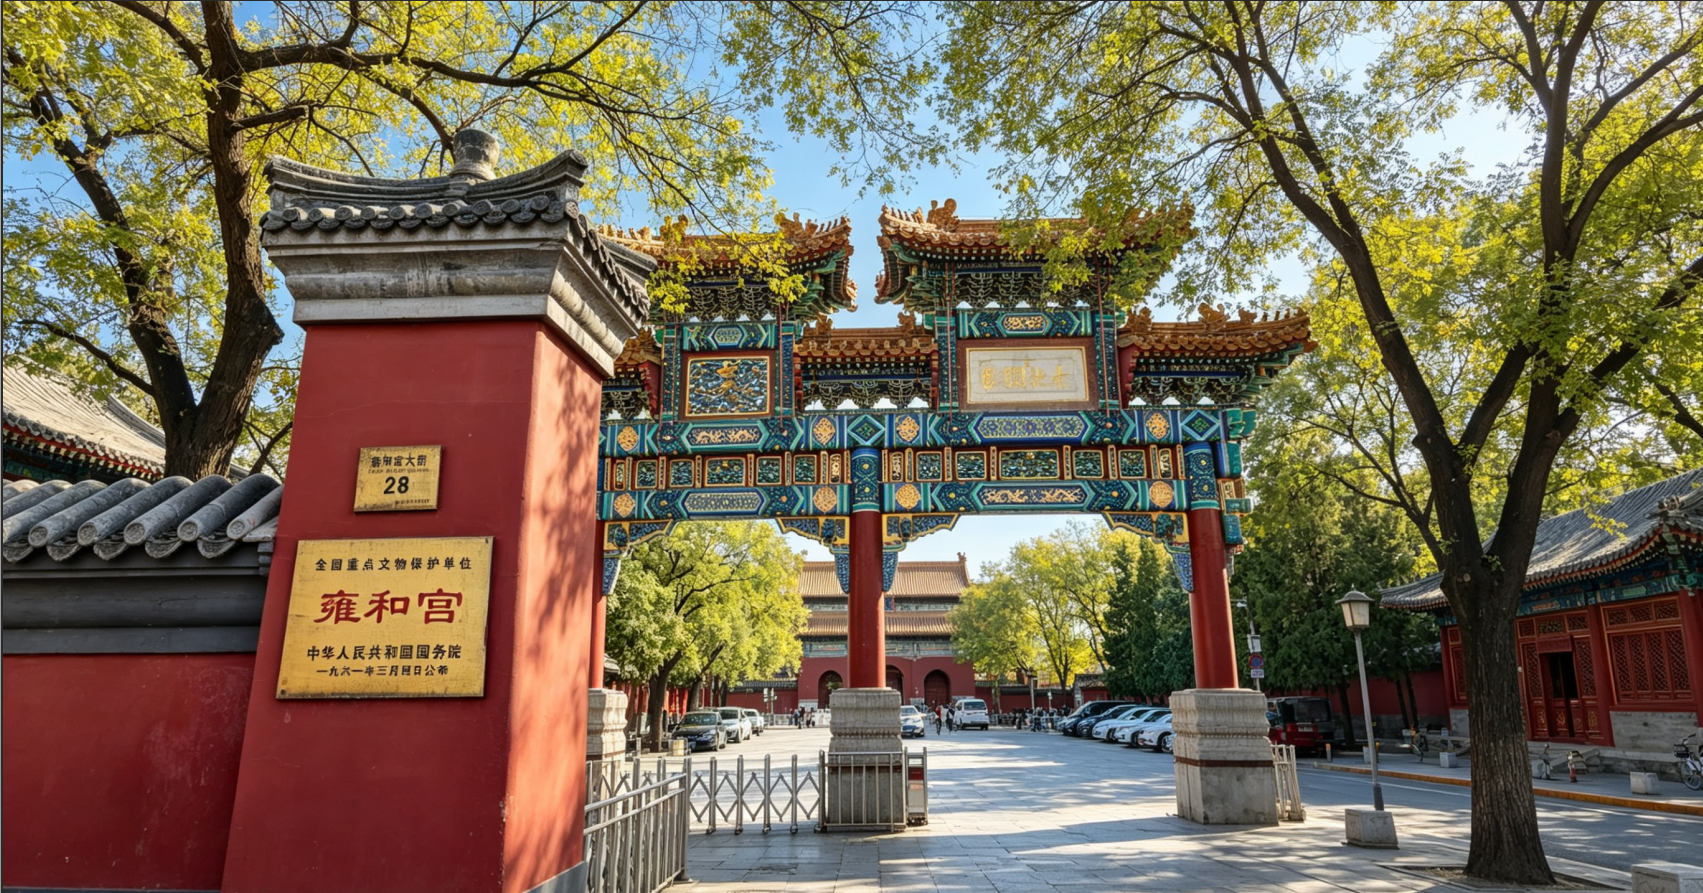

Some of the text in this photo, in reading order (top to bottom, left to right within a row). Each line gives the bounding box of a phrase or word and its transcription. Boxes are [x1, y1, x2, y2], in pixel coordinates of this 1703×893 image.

[383, 476, 410, 494] 28
[315, 557, 472, 571] 全国重点文物保护单位
[313, 588, 463, 624] 雍和宫
[307, 644, 462, 661] 中华人民共和国国务院
